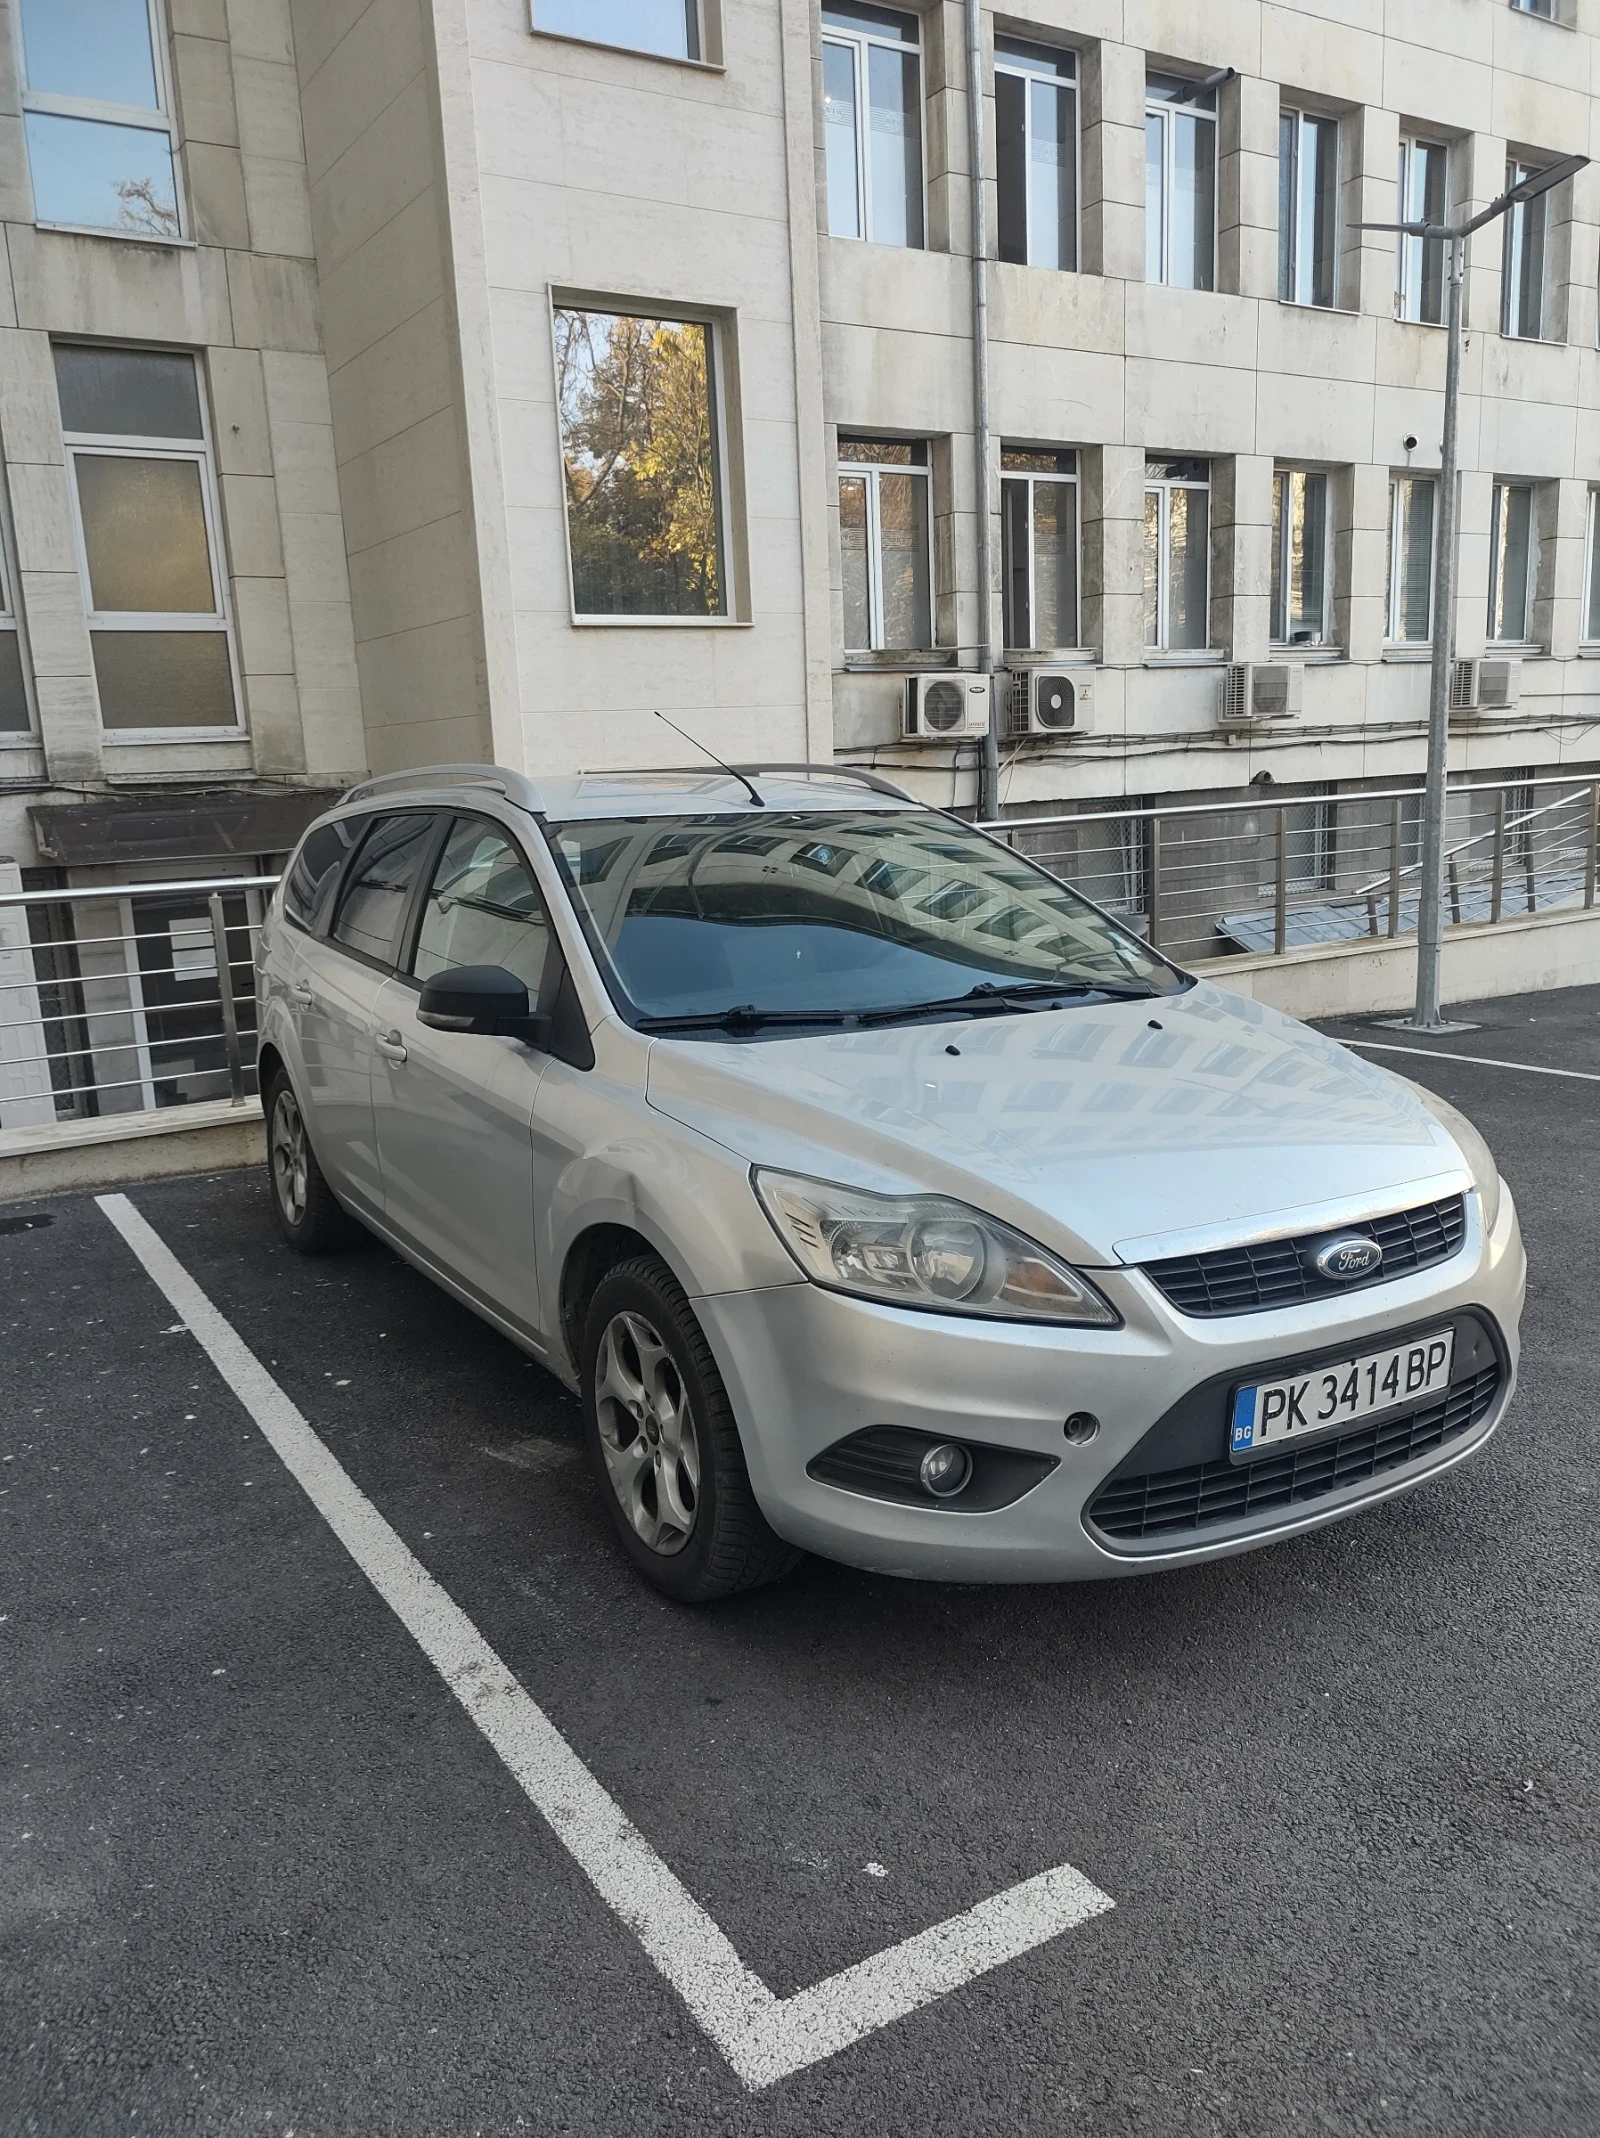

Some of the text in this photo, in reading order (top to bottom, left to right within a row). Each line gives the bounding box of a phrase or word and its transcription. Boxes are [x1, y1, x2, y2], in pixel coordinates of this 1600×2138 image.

[1338, 1248, 1371, 1271] Ford
[1317, 1354, 1400, 1420] 3414
[1234, 1425, 1252, 1441] BG
